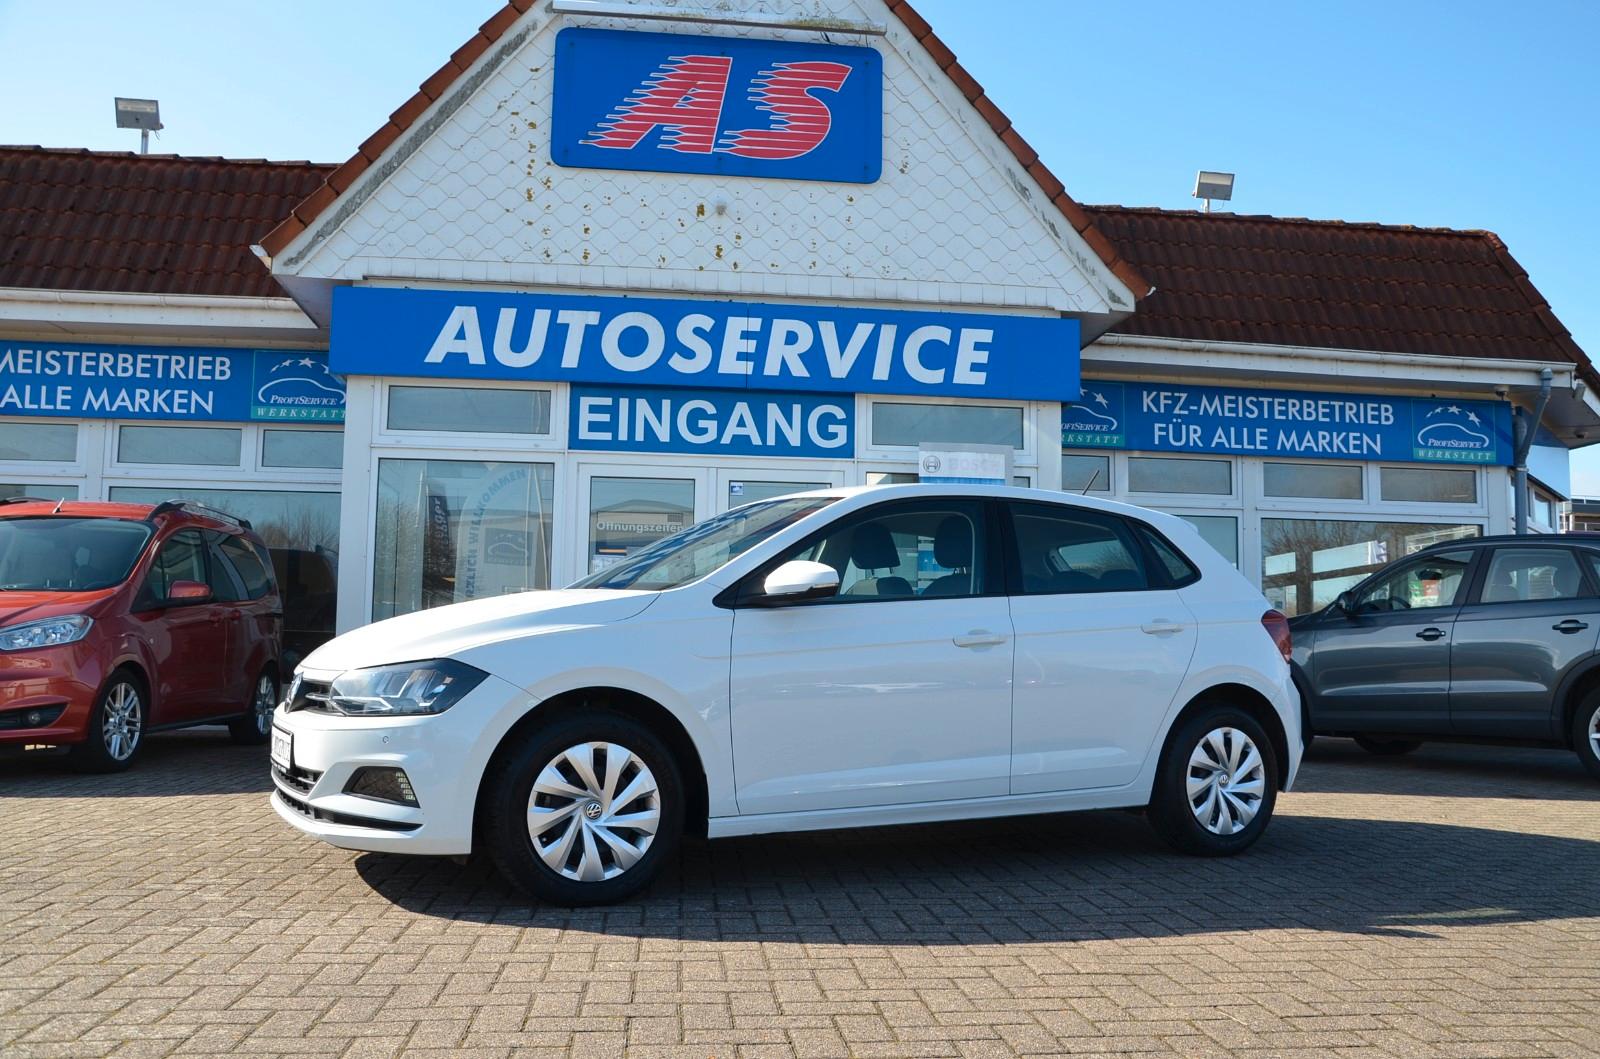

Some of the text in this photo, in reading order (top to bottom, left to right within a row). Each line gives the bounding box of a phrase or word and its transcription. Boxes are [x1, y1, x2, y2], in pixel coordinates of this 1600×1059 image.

[577, 53, 853, 160] AS
[424, 305, 994, 386] AUTOSERVICE
[0, 383, 214, 415] ALLE MARKEN
[1142, 390, 1395, 426] KFZ-MEISTERBETRIEB
[577, 397, 849, 449] EINGANG
[1154, 418, 1382, 456] FÜR ALLE MARKEN
[1418, 449, 1491, 460] WERKSTATT
